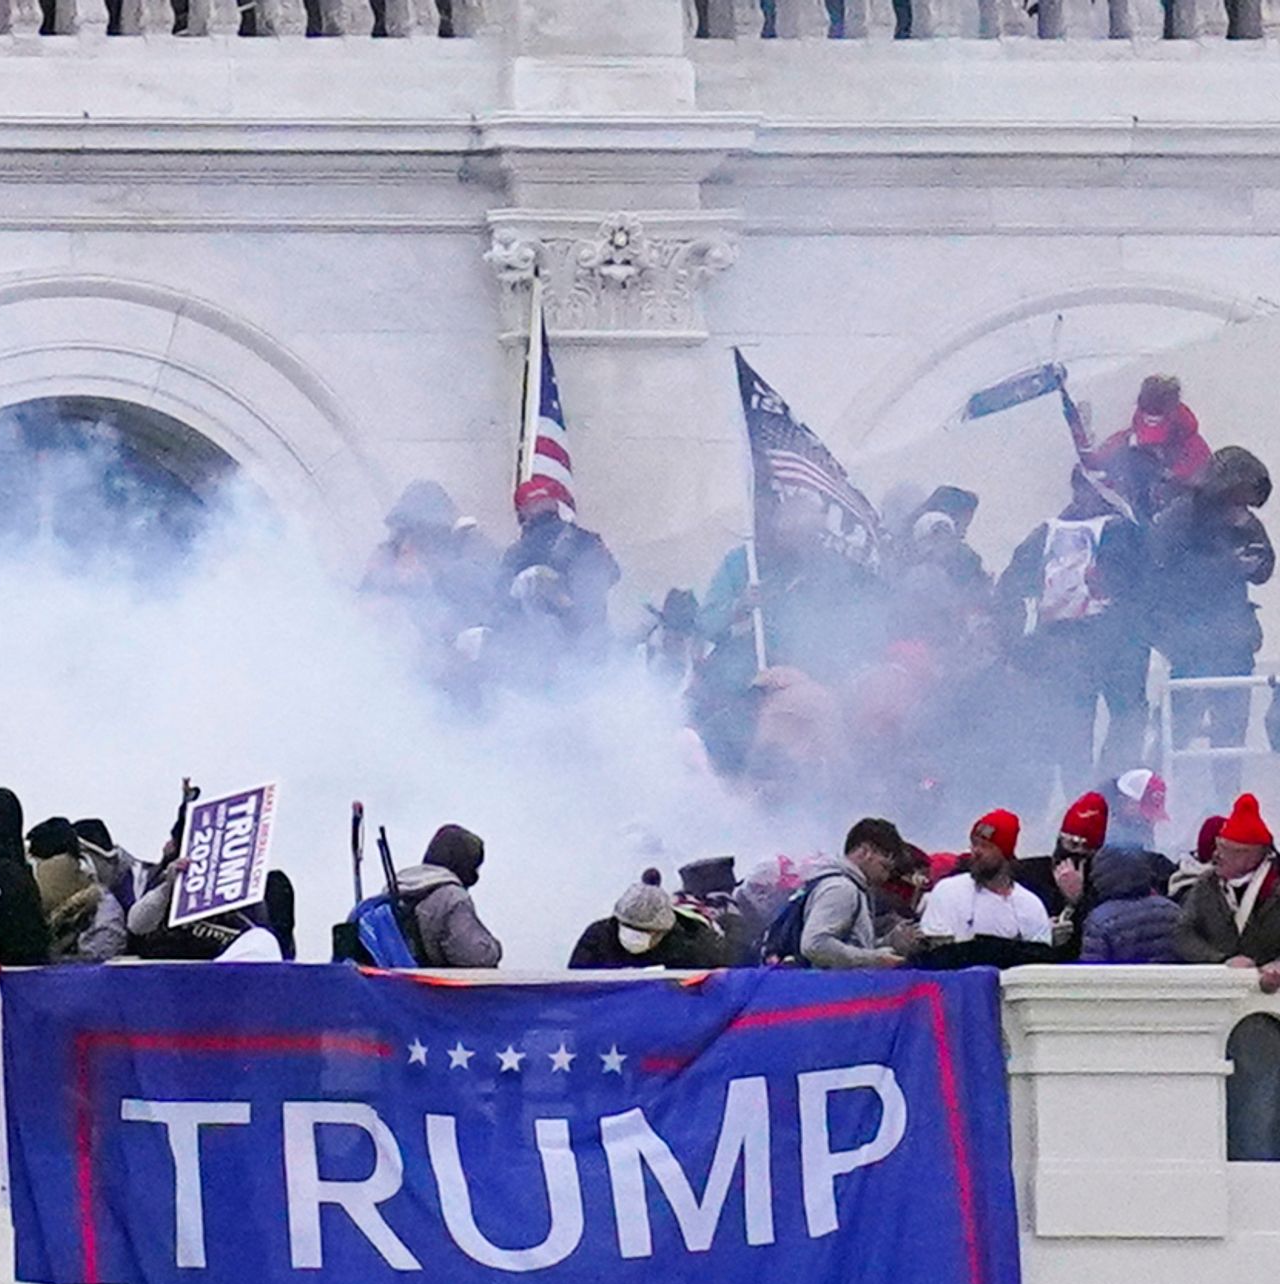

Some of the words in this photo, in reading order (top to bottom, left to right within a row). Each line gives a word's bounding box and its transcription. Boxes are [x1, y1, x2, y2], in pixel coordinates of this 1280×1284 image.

[186, 826, 214, 894] 2020
[215, 795, 257, 901] TRUMP
[120, 1062, 908, 1272] TRUMP
